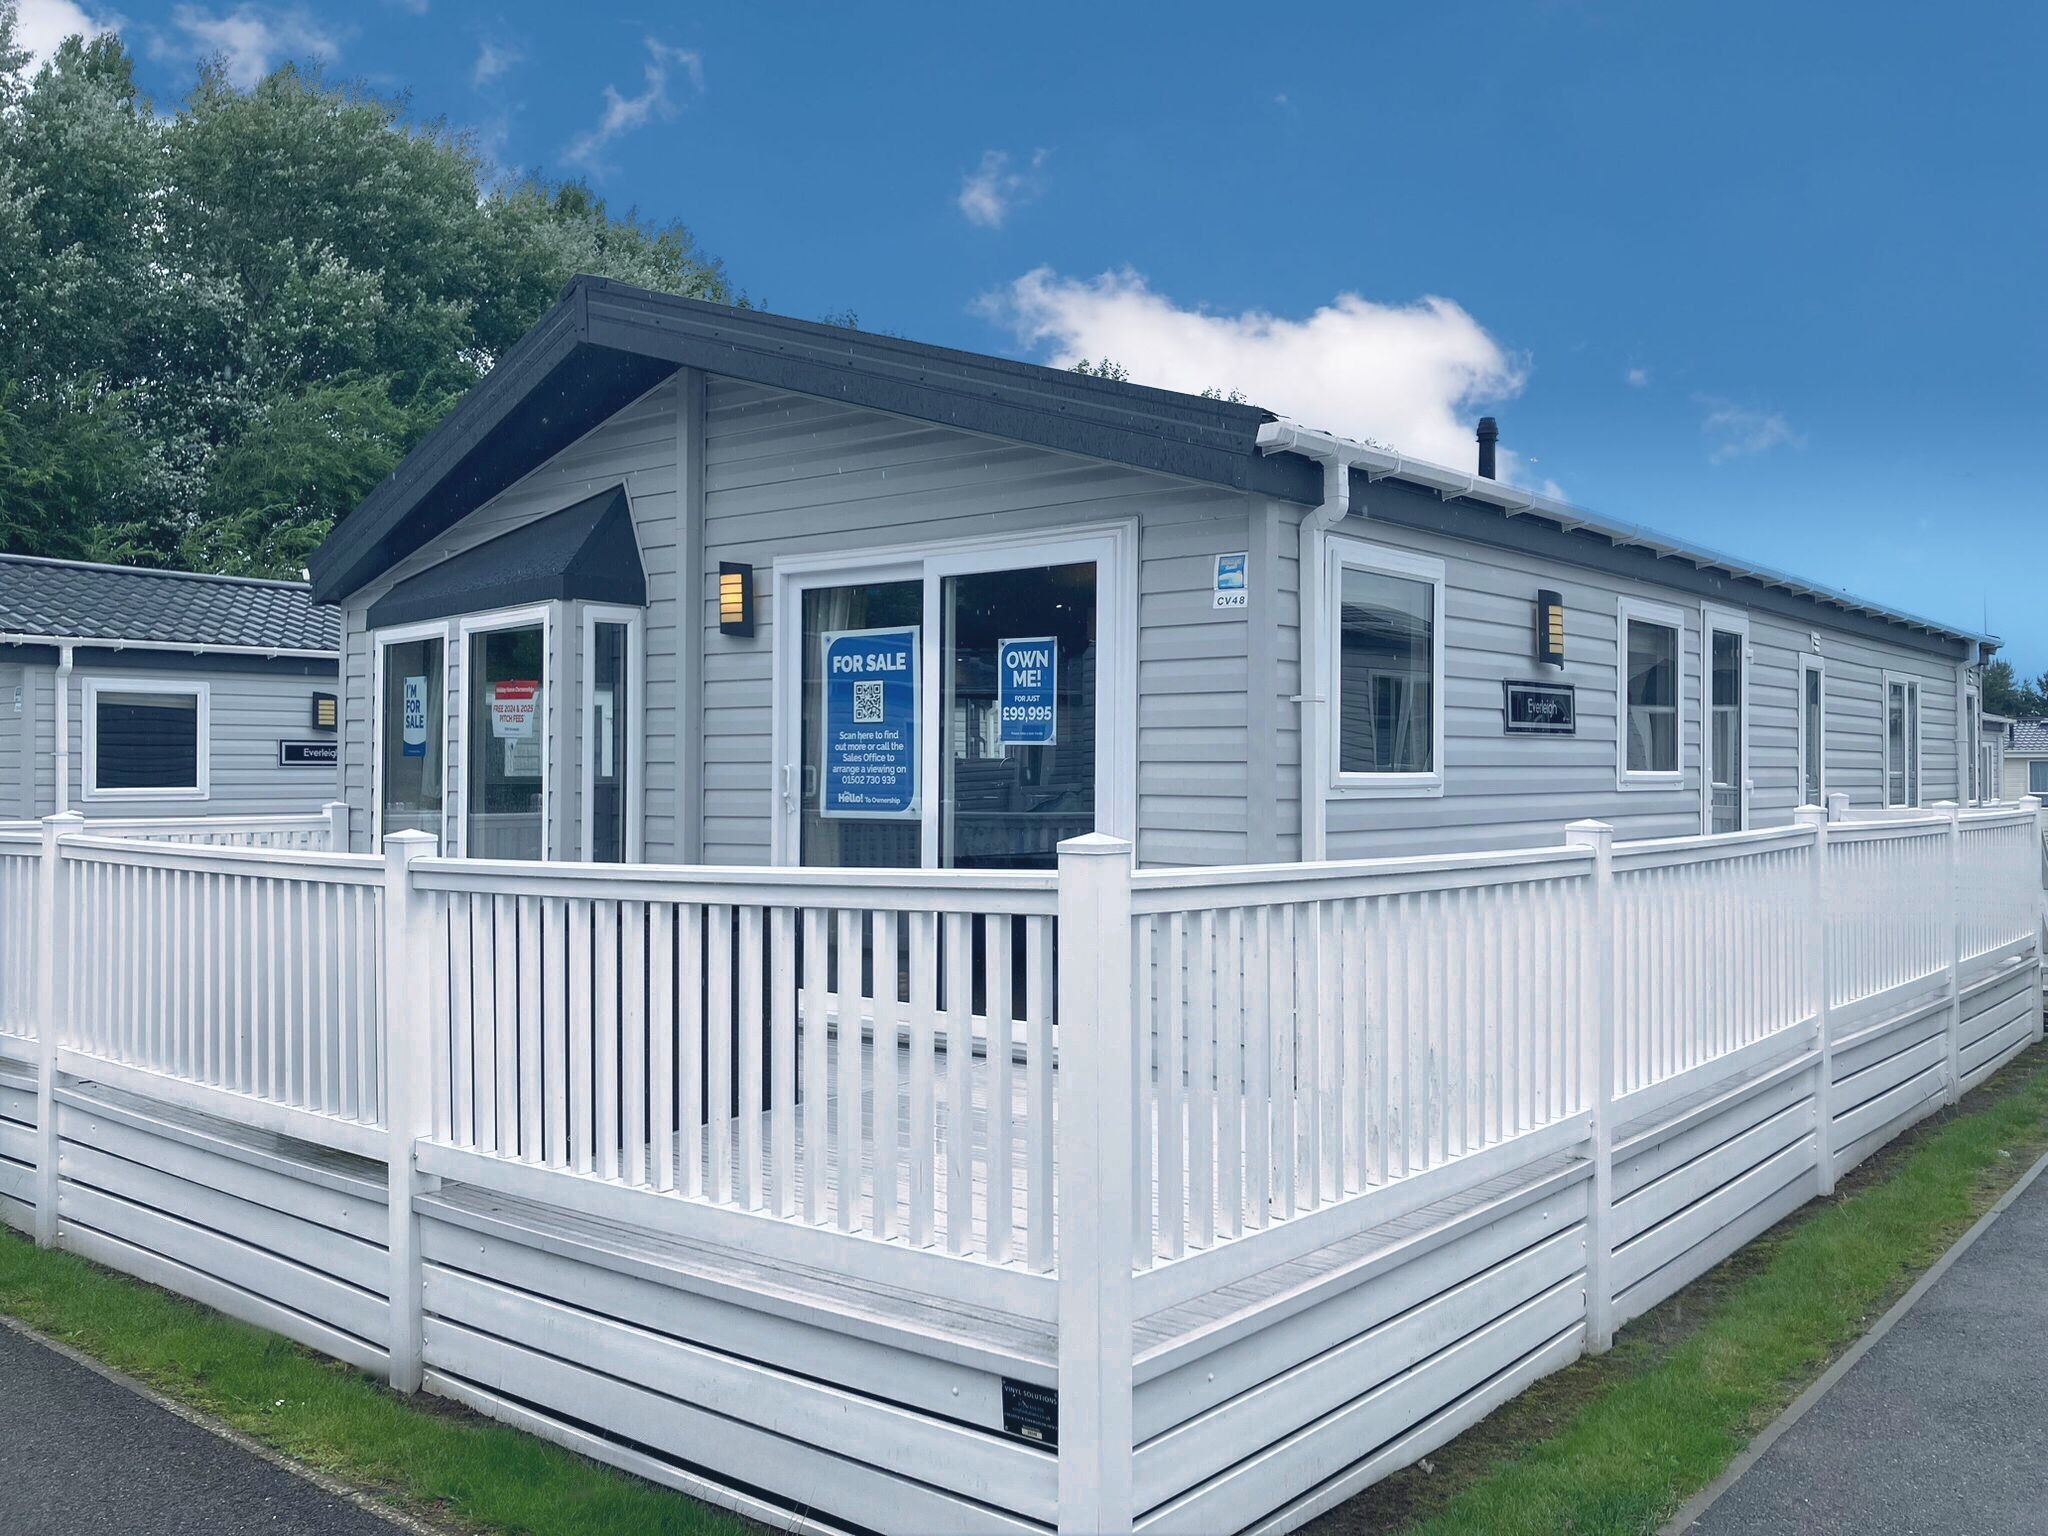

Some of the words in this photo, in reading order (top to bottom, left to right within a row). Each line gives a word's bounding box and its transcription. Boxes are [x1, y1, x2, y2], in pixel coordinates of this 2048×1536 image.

[1217, 596, 1245, 606] CV48
[833, 655, 863, 673] FOR
[866, 652, 906, 671] SALE
[1006, 650, 1048, 668] OWN
[1013, 670, 1041, 687] ME!
[406, 684, 417, 698] I'M
[406, 700, 420, 713] FOR
[493, 704, 504, 712] FREE
[505, 704, 515, 712] 2024
[521, 704, 534, 712] 2025
[1528, 698, 1557, 718] Everleigh
[500, 715, 513, 723] PITCH
[1003, 706, 1052, 723] £99,995
[406, 715, 424, 728] SALE
[840, 731, 857, 740] Scan
[858, 731, 874, 740] here
[875, 731, 883, 739] to
[884, 730, 899, 739] find
[835, 743, 847, 751] out
[847, 743, 866, 751] more
[876, 742, 890, 751] call
[891, 742, 904, 751] the
[303, 748, 337, 759] Everleig
[843, 753, 862, 762] Sales
[863, 753, 886, 762] Office
[887, 753, 895, 762] to
[832, 766, 860, 775] arrange
[867, 764, 895, 775] viewing
[842, 776, 865, 784] 01502
[866, 776, 880, 784] 730
[882, 776, 896, 784] 939
[838, 792, 864, 803] Hello!
[872, 797, 901, 805] Ownership
[1005, 1385, 1021, 1396] VINYL
[1023, 1390, 1058, 1405] SOLUTIONS
